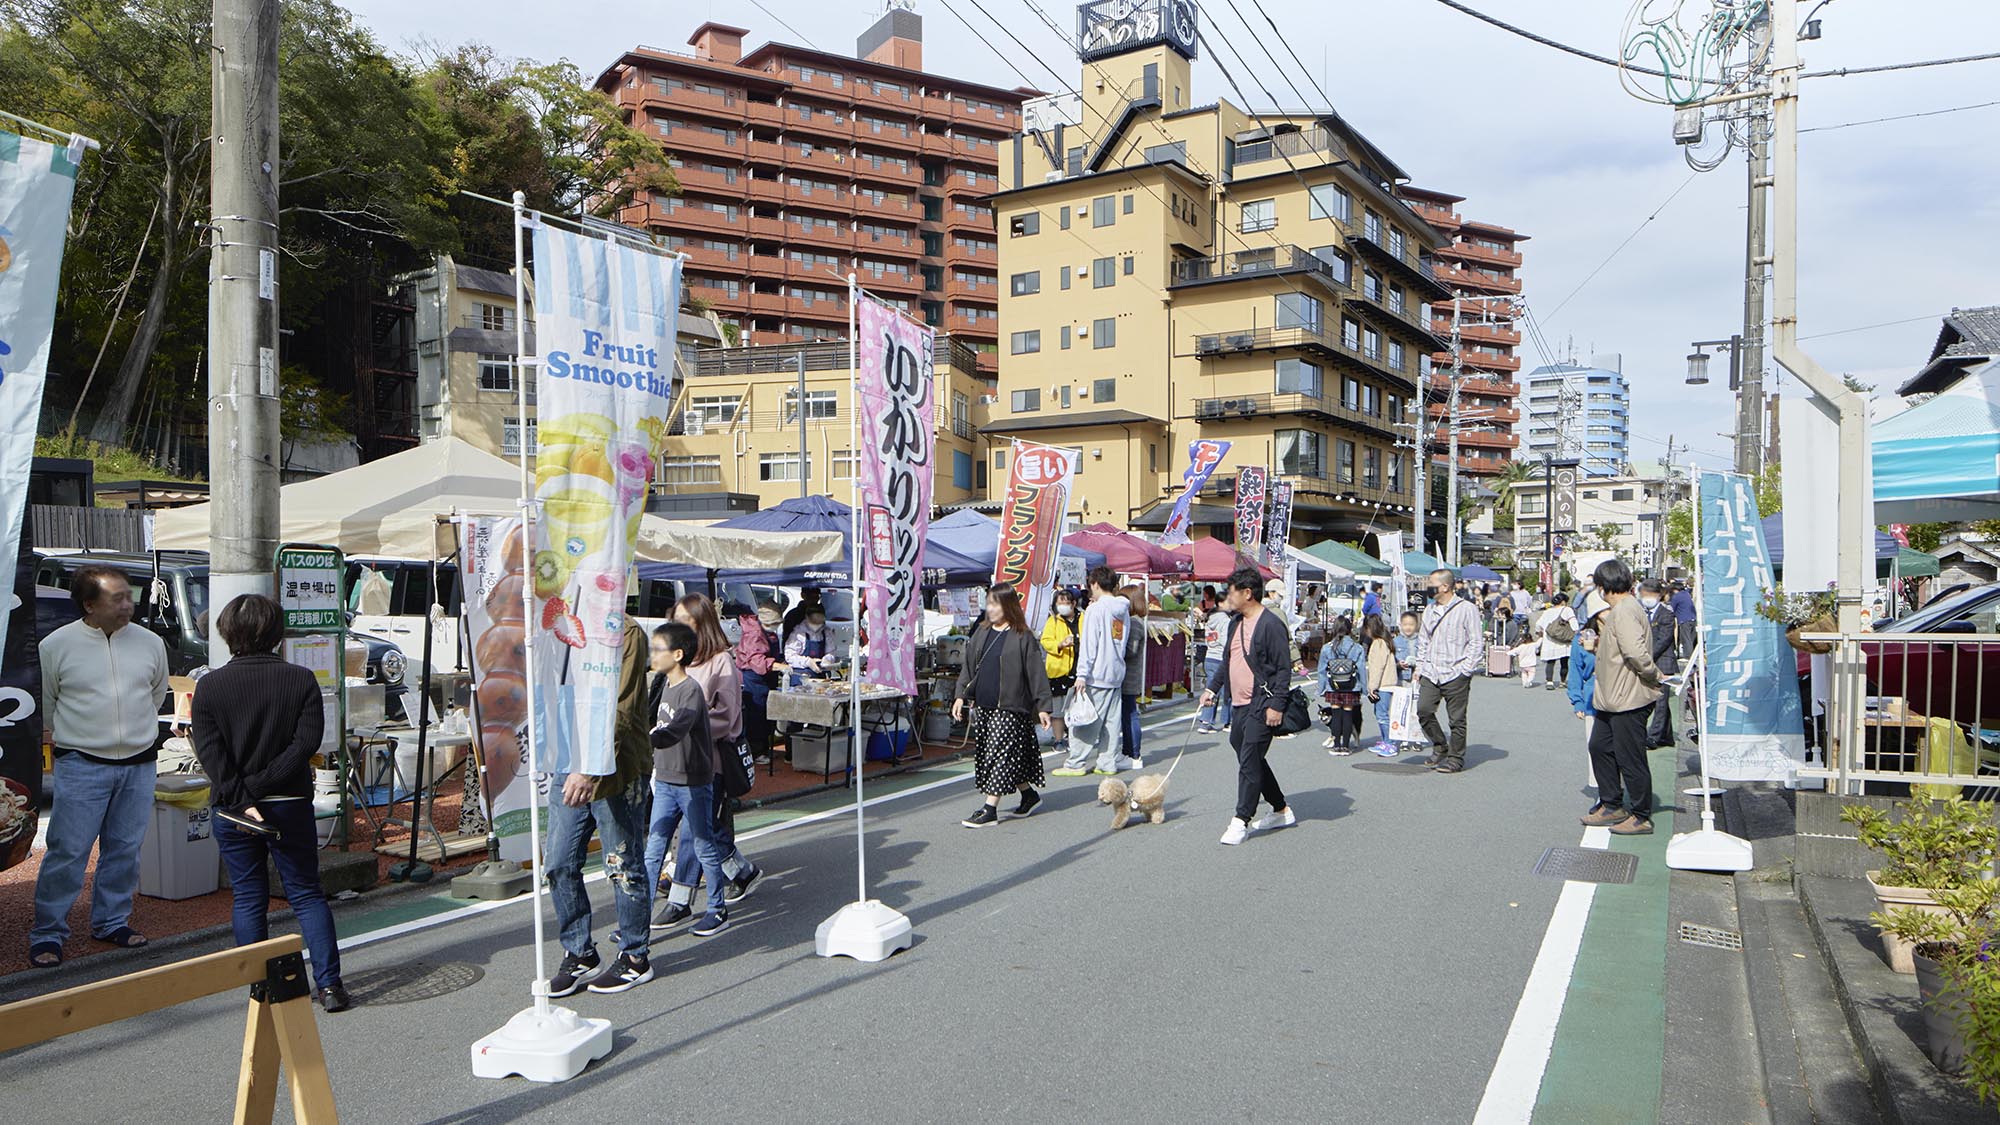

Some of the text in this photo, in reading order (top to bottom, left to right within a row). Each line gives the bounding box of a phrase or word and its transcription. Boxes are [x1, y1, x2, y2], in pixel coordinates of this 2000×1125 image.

[582, 329, 658, 369] Fruit
[546, 350, 671, 399] Smoothie
[1021, 455, 1065, 480] 旨い
[872, 513, 892, 562] 元祖
[285, 553, 336, 567] バスのりば
[288, 612, 336, 625] 伊豆箱根バス
[1714, 499, 1754, 728] ユナイテッド
[737, 744, 747, 756] LE
